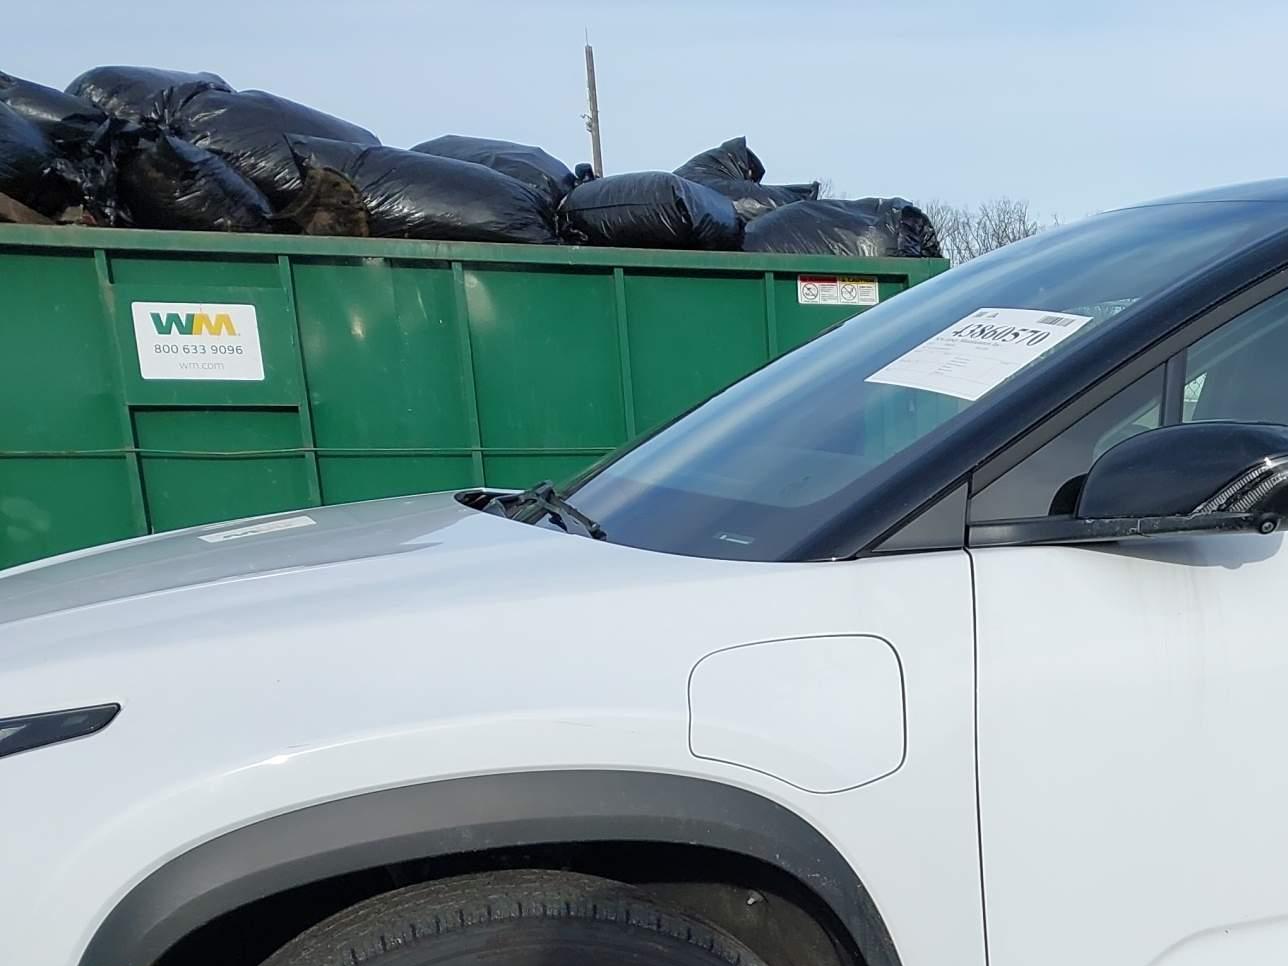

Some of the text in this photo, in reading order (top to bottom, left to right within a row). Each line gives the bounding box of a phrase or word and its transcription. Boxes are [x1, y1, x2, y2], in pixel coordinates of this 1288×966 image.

[150, 312, 236, 336] WM
[952, 324, 1050, 347] 43860570
[154, 344, 243, 355] 800 633 9096
[179, 361, 225, 370] wm.com
